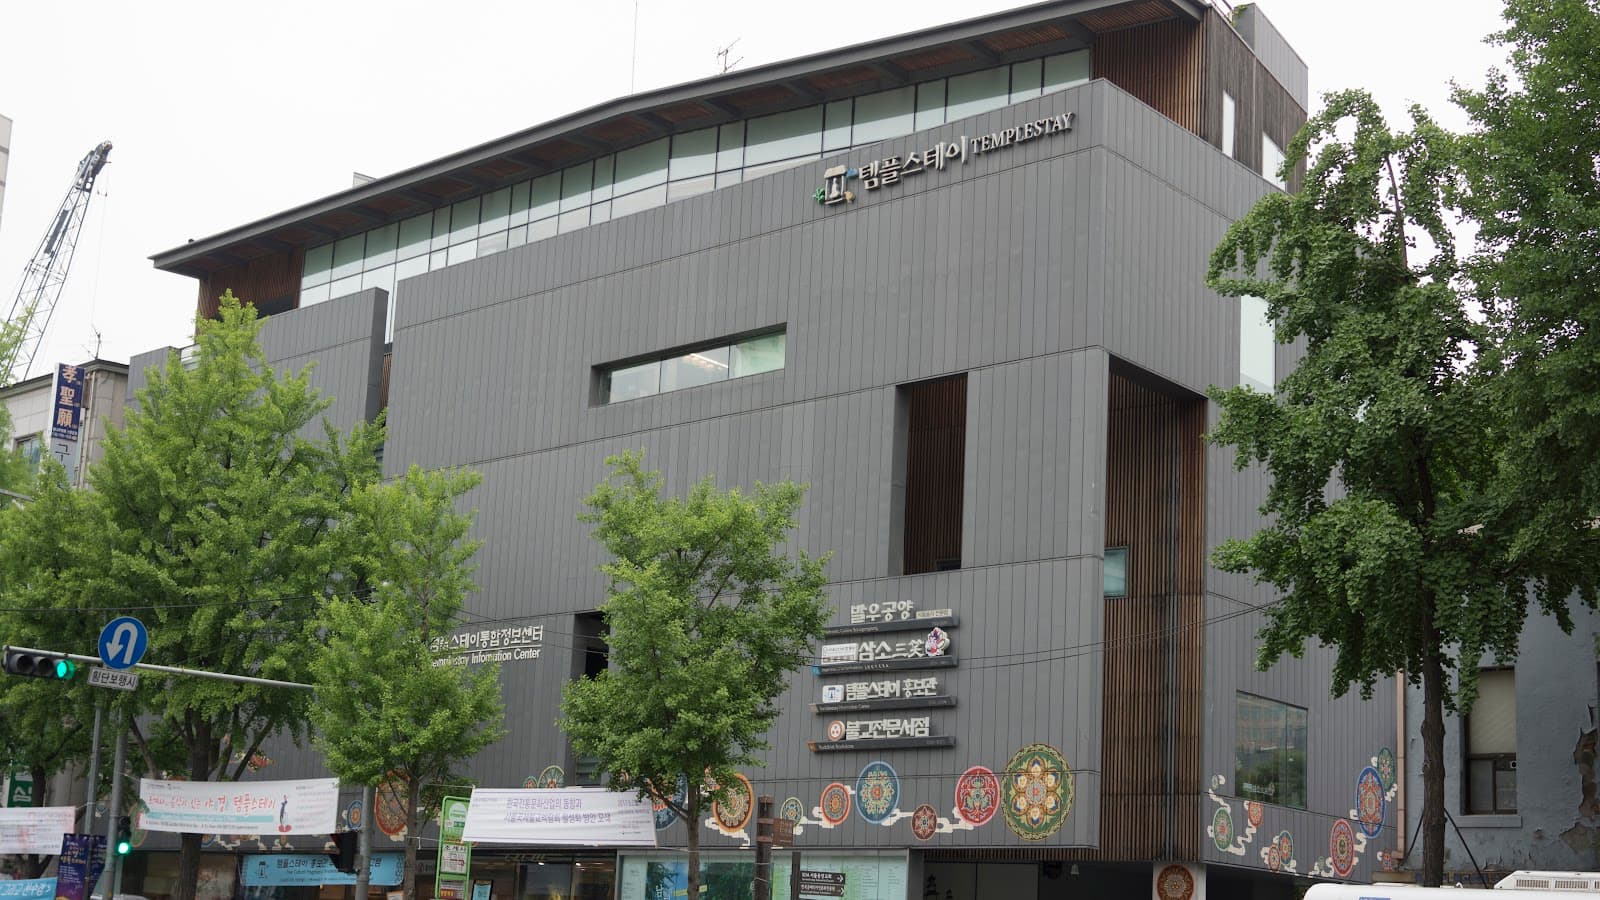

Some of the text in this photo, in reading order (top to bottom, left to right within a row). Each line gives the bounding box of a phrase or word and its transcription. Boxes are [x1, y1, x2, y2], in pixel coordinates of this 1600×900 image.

[970, 111, 1075, 154] TEMPLESTAY
[858, 135, 968, 190] 템플스테이
[850, 600, 914, 624] 발우공양
[513, 647, 541, 660] Center
[91, 670, 136, 688] 횡단보행시
[845, 677, 938, 701] 템플스테이 홍보관
[845, 717, 930, 740] 불교전문서점
